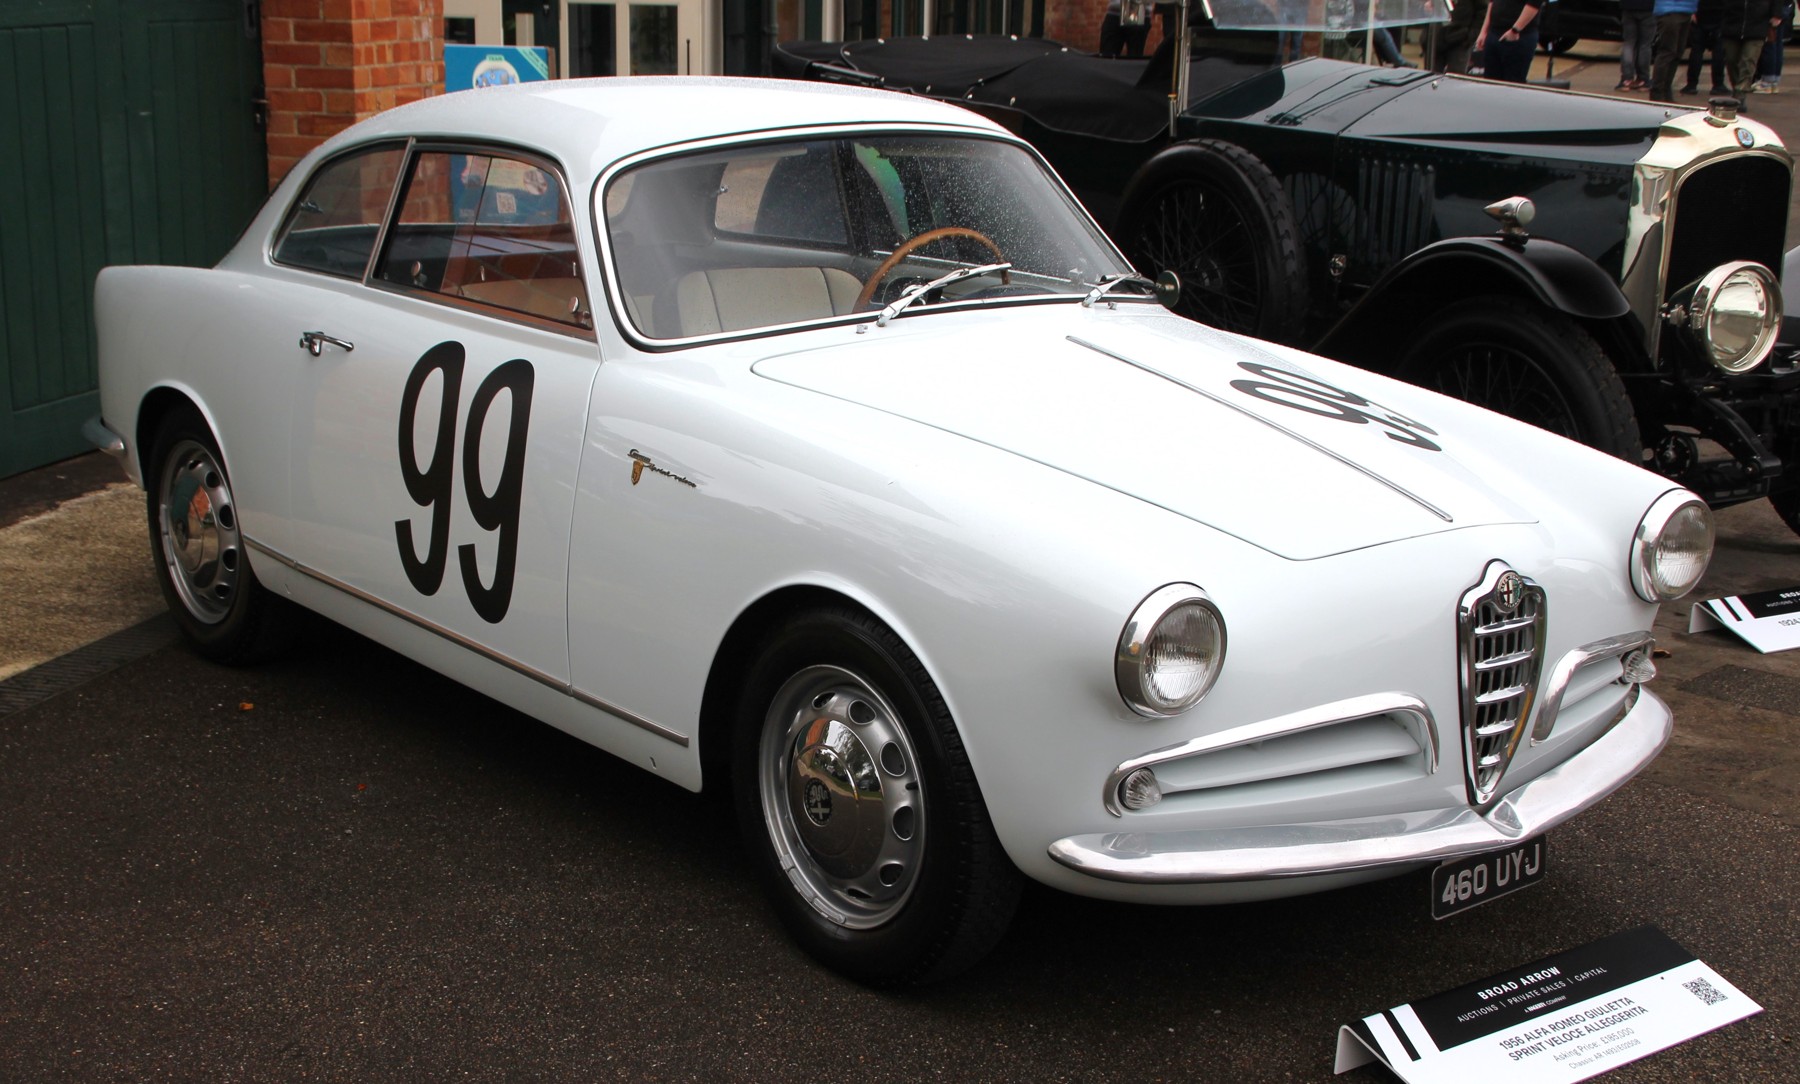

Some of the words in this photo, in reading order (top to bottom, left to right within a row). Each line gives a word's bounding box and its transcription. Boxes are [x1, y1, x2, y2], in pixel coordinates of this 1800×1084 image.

[1229, 361, 1442, 451] 99
[395, 340, 535, 624] 99
[1442, 863, 1488, 905] 460
[1496, 843, 1540, 887] UYJ
[1457, 1004, 1499, 1023] AUCTIONS
[1507, 989, 1541, 1006] PRIVATE
[1540, 980, 1567, 994] SALES
[1574, 966, 1608, 982] CAPITAL
[1477, 981, 1519, 1000] BROAD
[1519, 966, 1561, 987] ARROW
[1499, 1035, 1525, 1051] 1956
[1523, 1027, 1552, 1043] ALFA
[1548, 1014, 1586, 1032] ROMEO
[1583, 996, 1635, 1020] GIULIETTA
[1508, 1041, 1548, 1062] SPRINT
[1544, 1028, 1587, 1048] VELOCE
[1584, 1005, 1649, 1035] ALLEGGERITA
[1552, 1047, 1582, 1063] Asking
